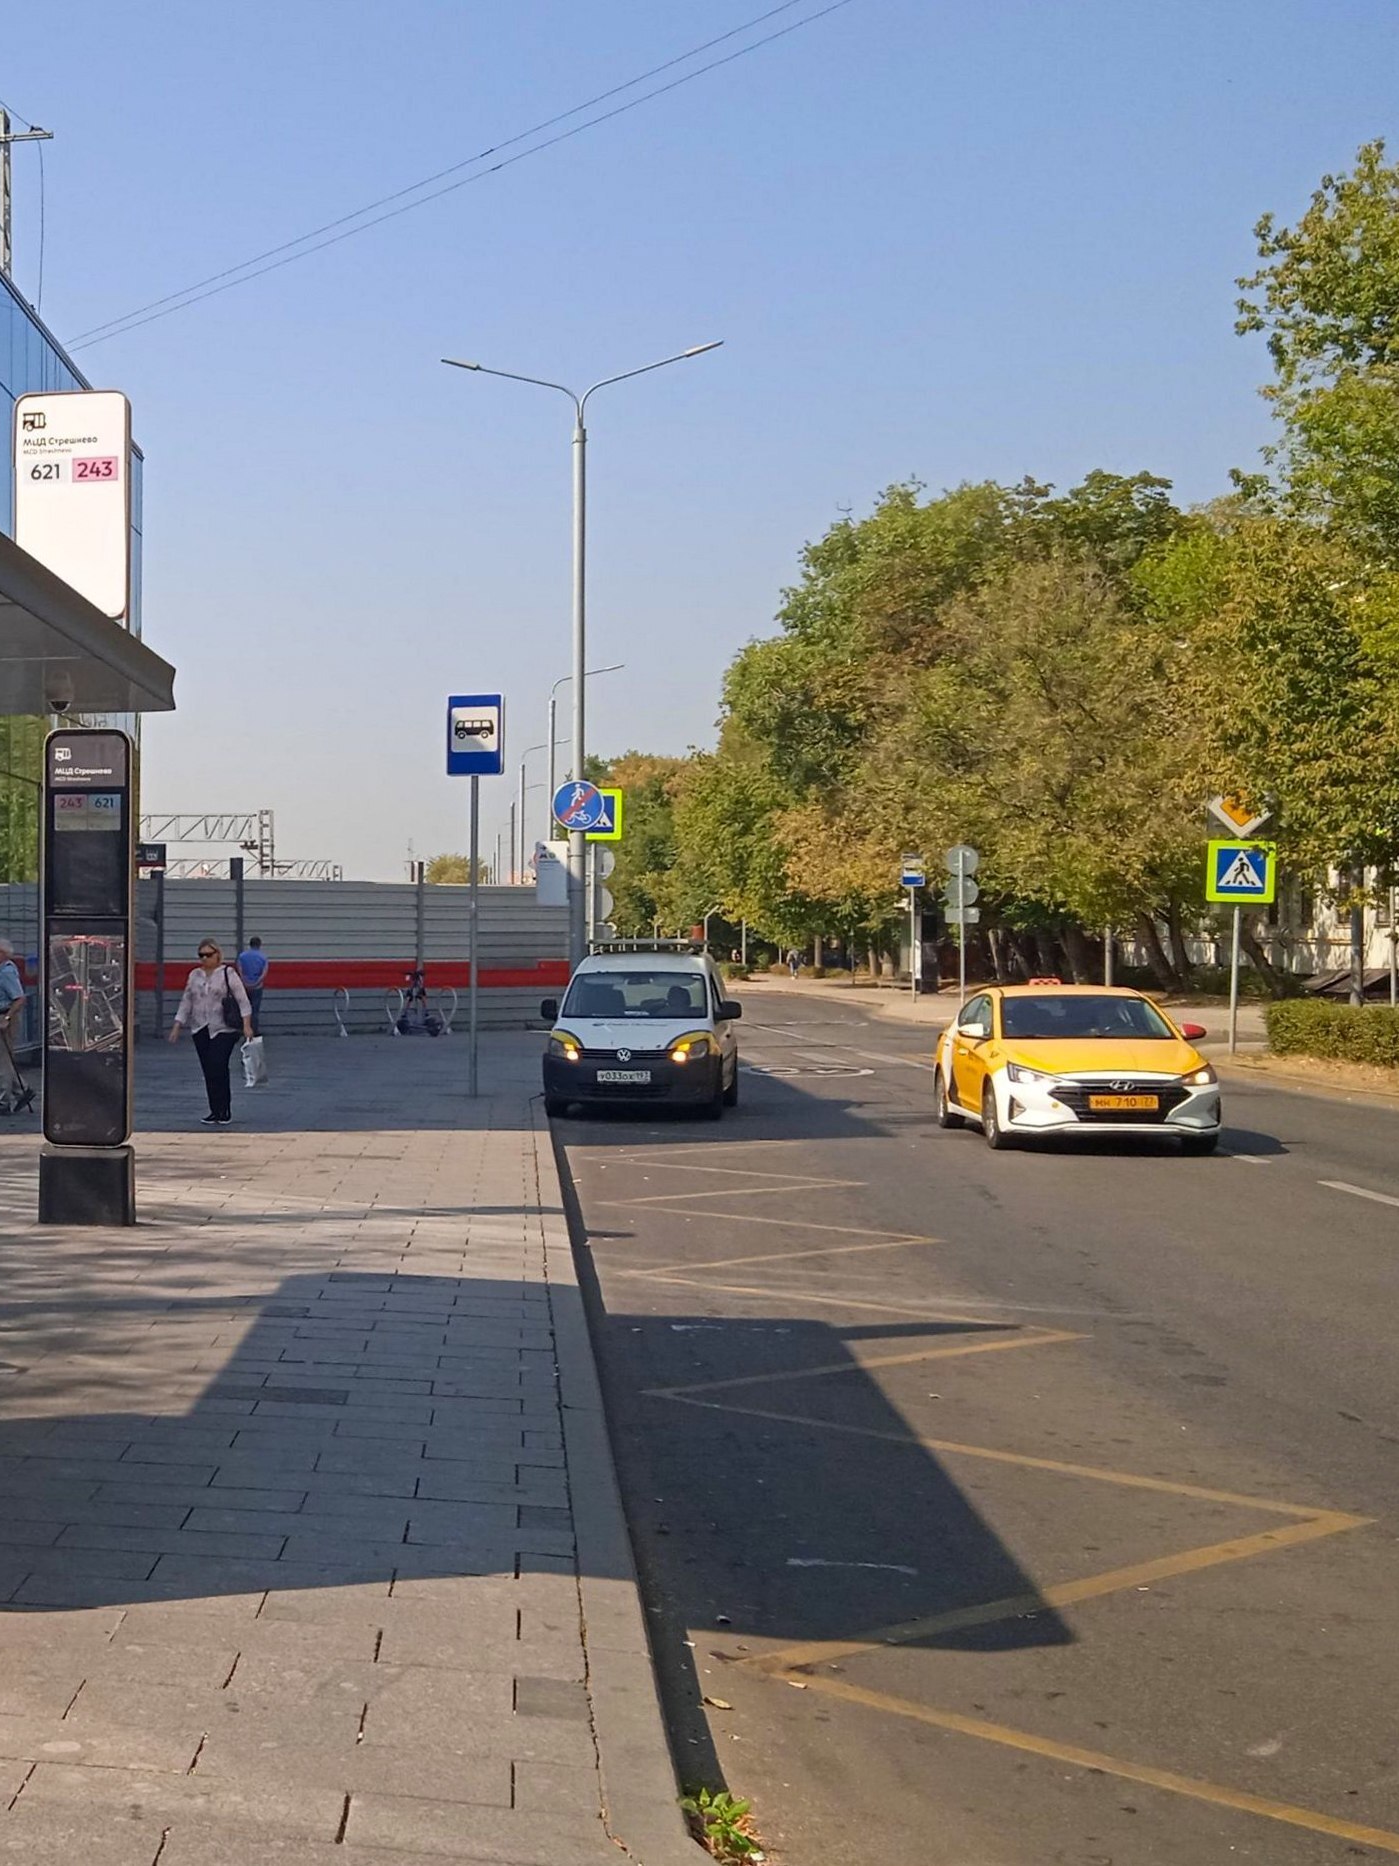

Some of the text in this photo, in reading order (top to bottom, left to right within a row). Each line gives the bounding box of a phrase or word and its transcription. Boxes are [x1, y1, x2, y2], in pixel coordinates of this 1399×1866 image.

[48, 436, 98, 446] Стрешнево
[31, 461, 112, 480] 621 243
[60, 797, 114, 809] 243 621
[1115, 1097, 1137, 1107] 710
